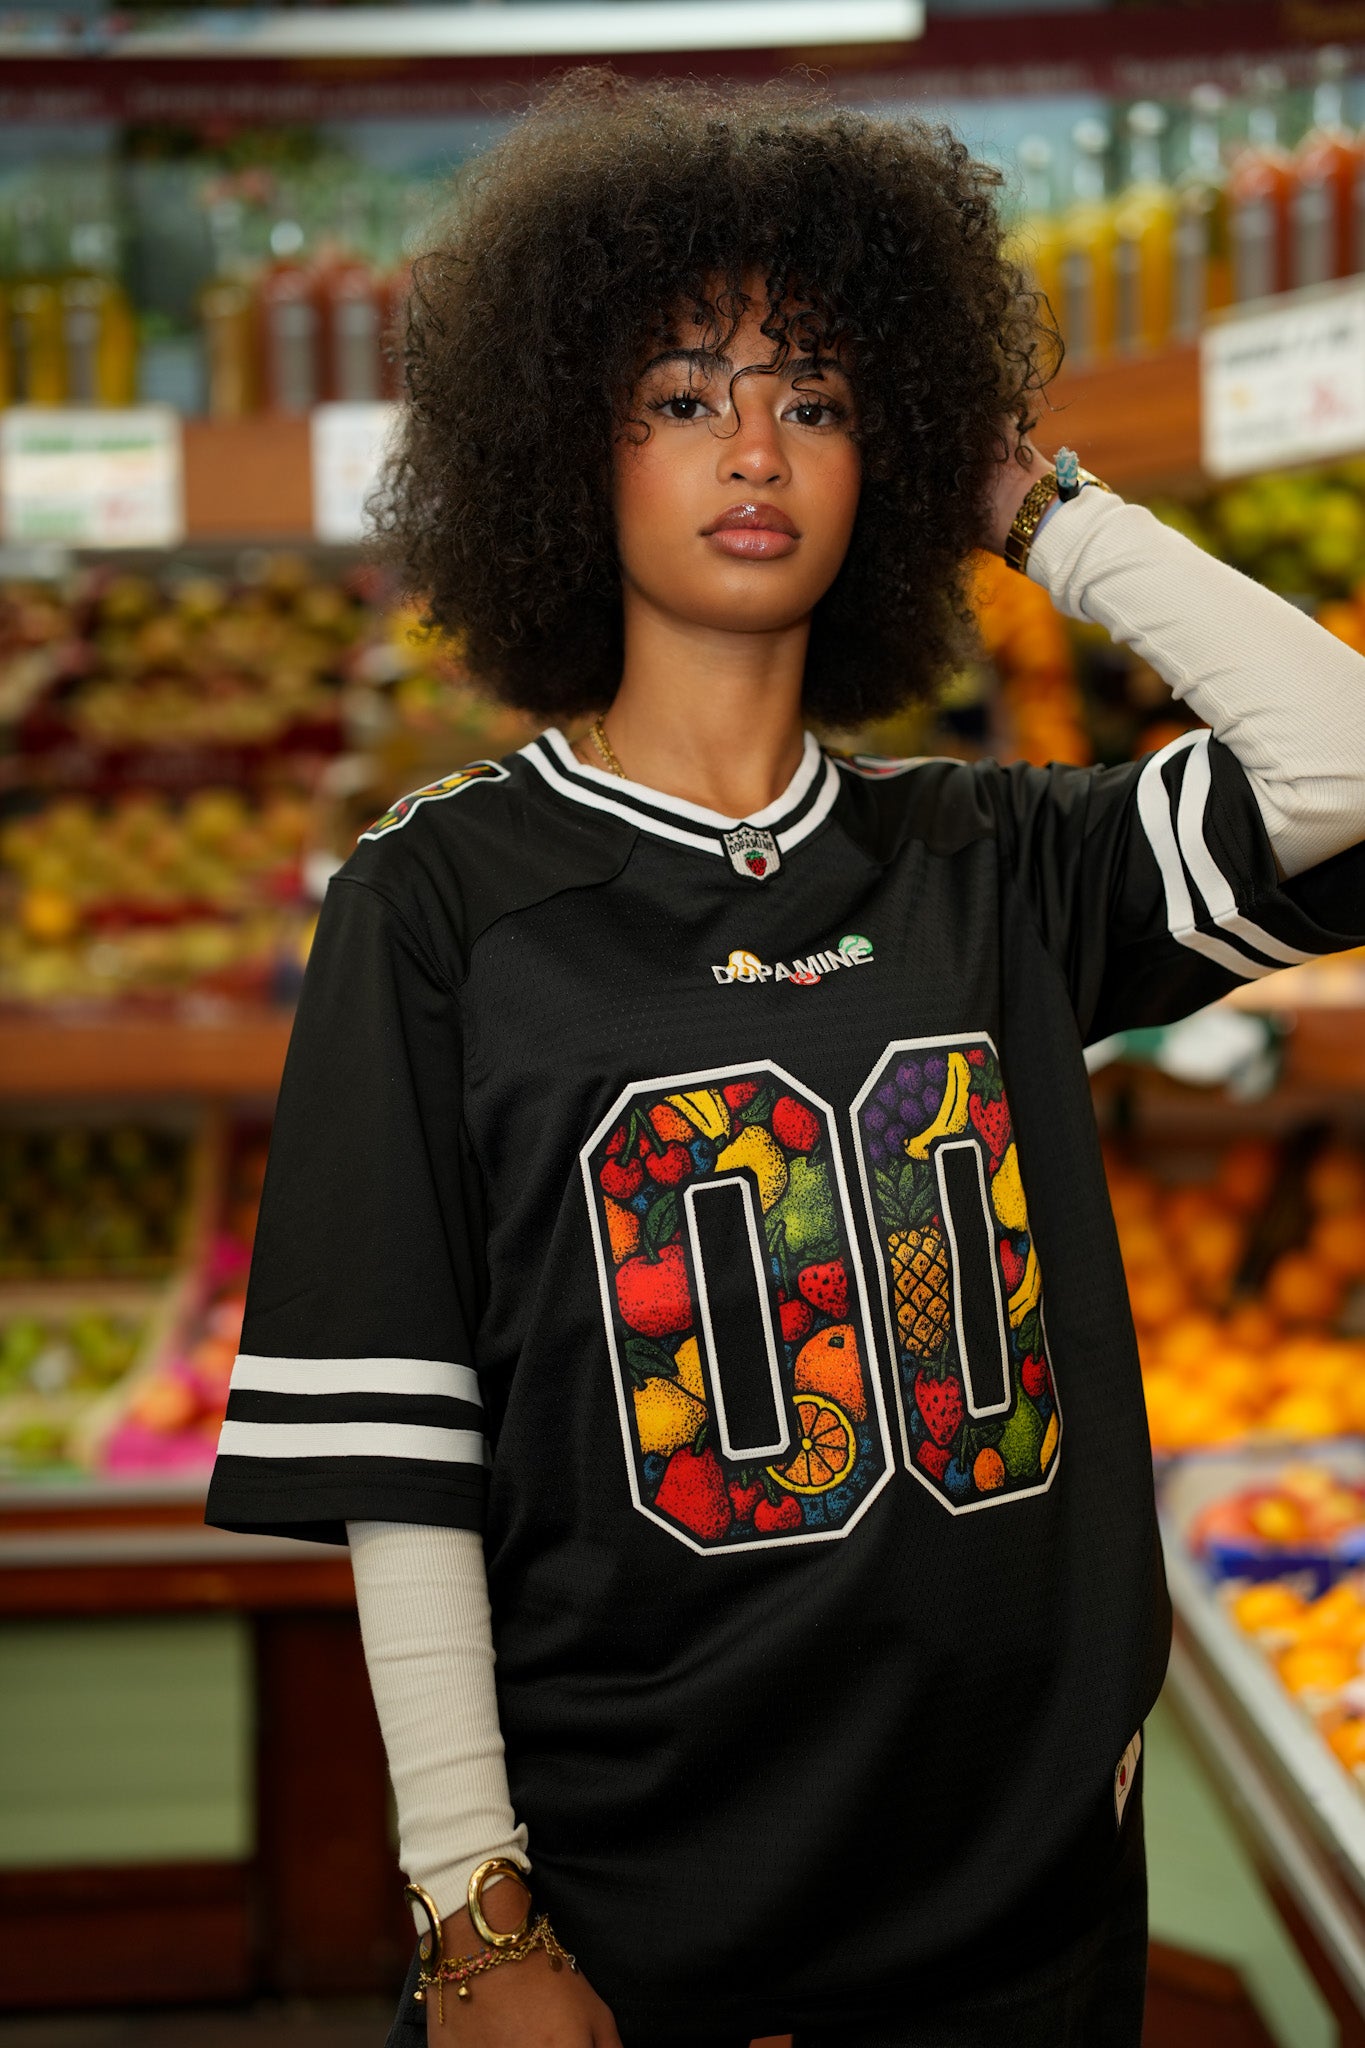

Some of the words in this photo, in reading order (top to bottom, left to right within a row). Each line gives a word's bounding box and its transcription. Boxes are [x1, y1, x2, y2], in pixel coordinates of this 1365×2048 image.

[729, 837, 774, 855] DOPAMINE
[711, 944, 874, 985] DOPAMINE
[578, 1031, 1063, 1557] 00
